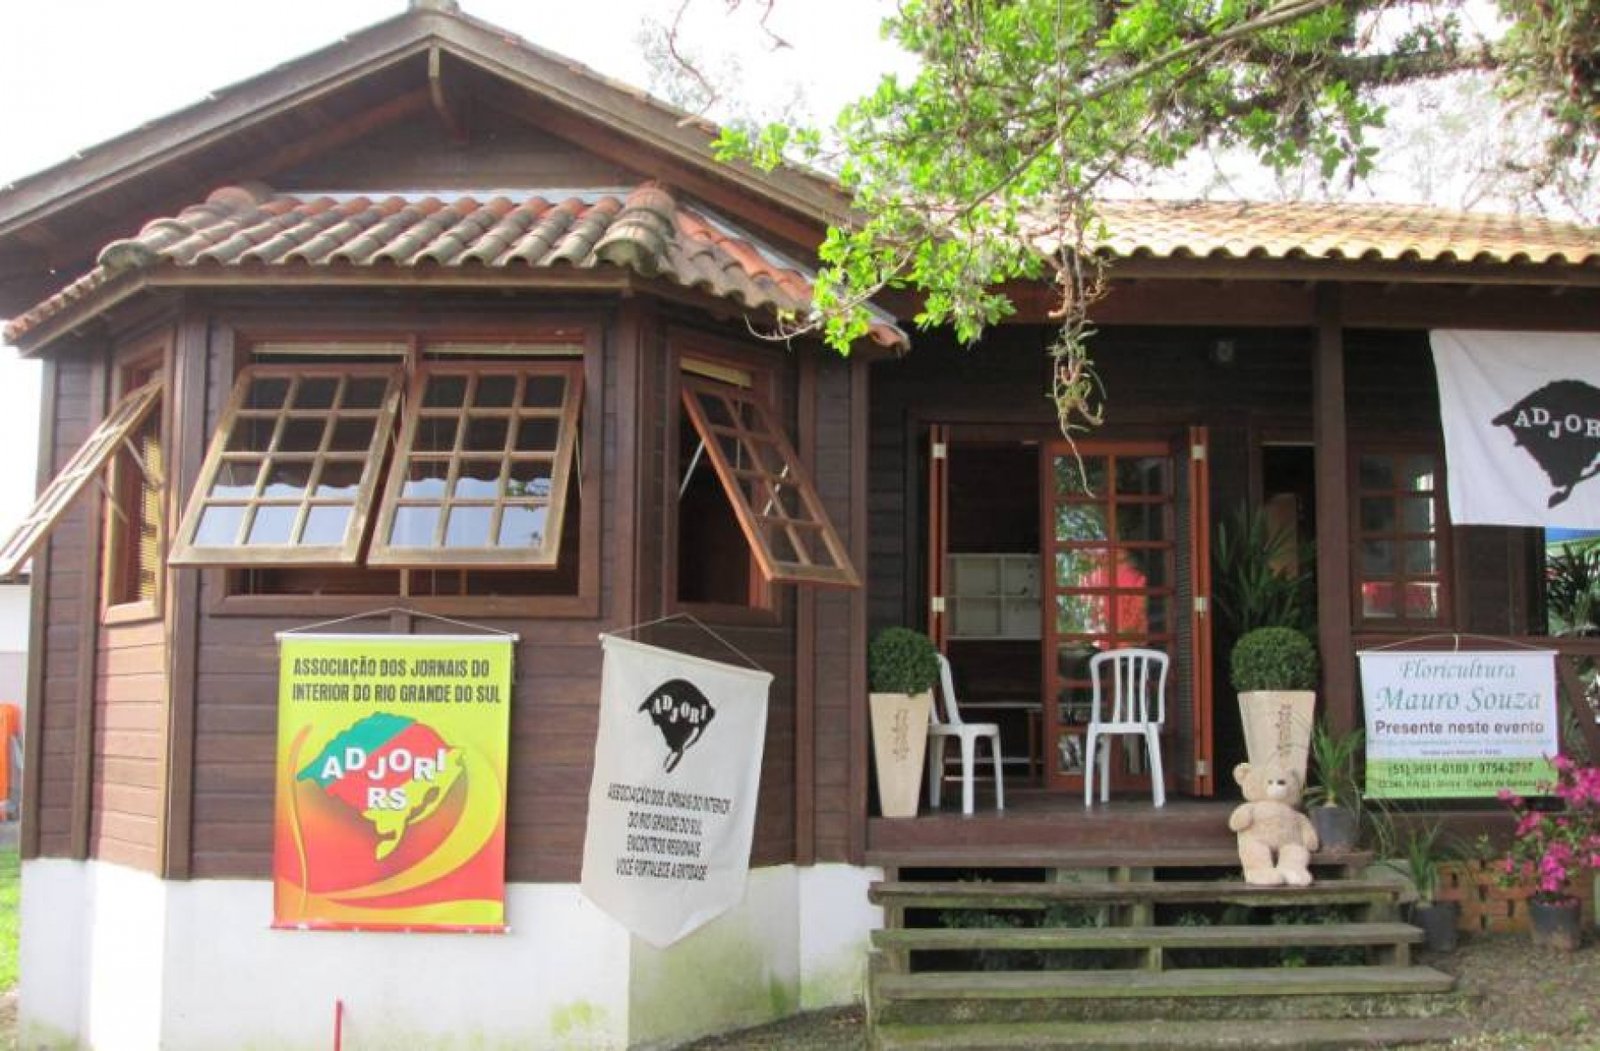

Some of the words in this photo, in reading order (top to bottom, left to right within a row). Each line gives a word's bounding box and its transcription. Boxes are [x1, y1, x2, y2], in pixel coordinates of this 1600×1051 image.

[293, 656, 376, 679] ASSOCIAÇÃO
[380, 659, 406, 676] DOS
[411, 659, 468, 677] JORNAIS
[472, 660, 489, 677] DO
[1400, 657, 1517, 679] Floricultura
[293, 683, 349, 701] INTERIOR
[353, 685, 370, 701] DO
[375, 685, 396, 702] RIO
[400, 685, 450, 703] GRANDE
[455, 685, 472, 703] DO
[476, 686, 501, 703] SUL
[1375, 687, 1459, 712] Mauro
[1466, 687, 1541, 712] Souza
[652, 694, 708, 724] ADJORI
[1375, 720, 1442, 735] Presente
[1449, 722, 1489, 734] neste
[1494, 722, 1544, 734] evento
[321, 747, 447, 782] ADJORI
[367, 787, 408, 811] RS
